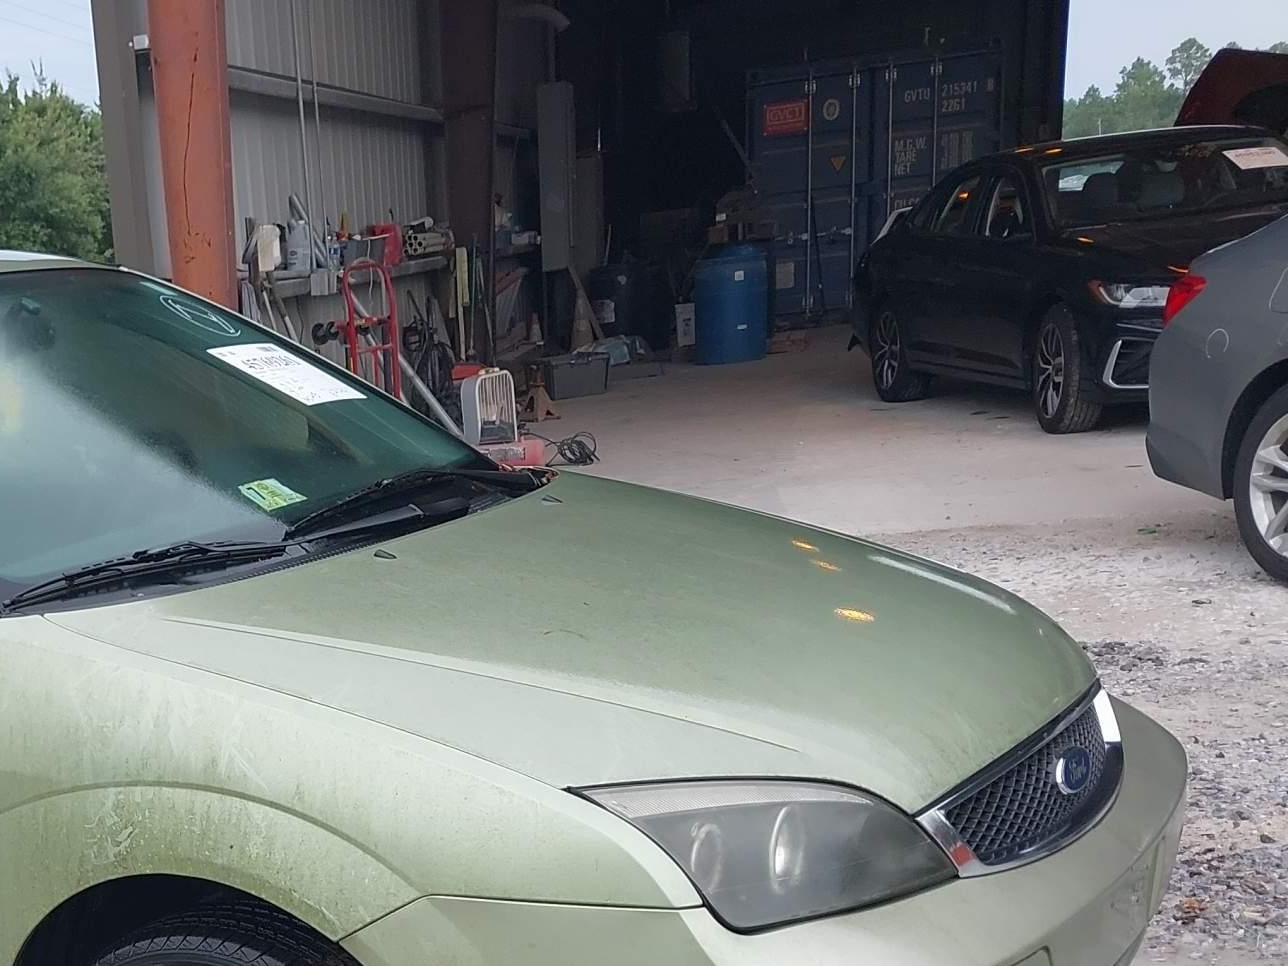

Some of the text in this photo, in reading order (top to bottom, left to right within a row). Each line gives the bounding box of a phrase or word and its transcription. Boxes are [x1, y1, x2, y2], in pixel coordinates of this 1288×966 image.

[904, 87, 930, 103] GVTU
[895, 149, 917, 163] TARE
[894, 162, 911, 177] NET
